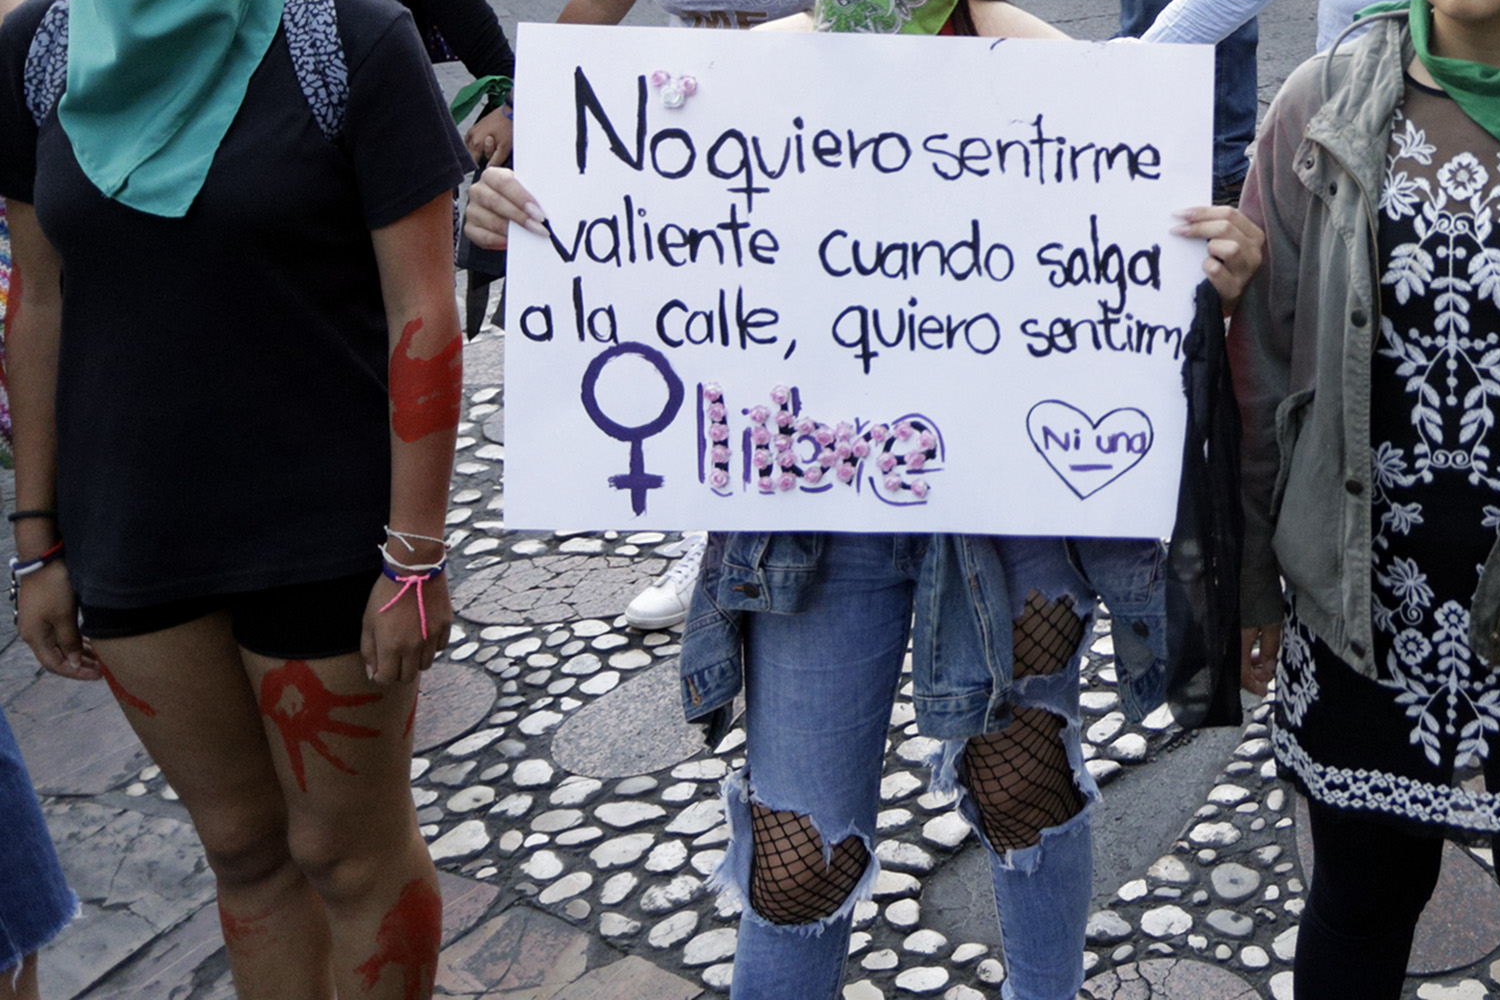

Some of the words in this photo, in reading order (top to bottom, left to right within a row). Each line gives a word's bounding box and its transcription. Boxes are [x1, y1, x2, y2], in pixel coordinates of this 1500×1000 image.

[574, 65, 697, 180] No
[706, 116, 912, 213] quiero
[922, 113, 1162, 185] sentirme
[542, 194, 780, 268] valiente
[818, 218, 1015, 281] cuando
[1036, 214, 1162, 325] salga
[519, 304, 554, 342] a
[572, 276, 620, 346] la
[832, 296, 1001, 375] quiero
[1041, 425, 1081, 452] Ni
[1095, 430, 1147, 454] una
